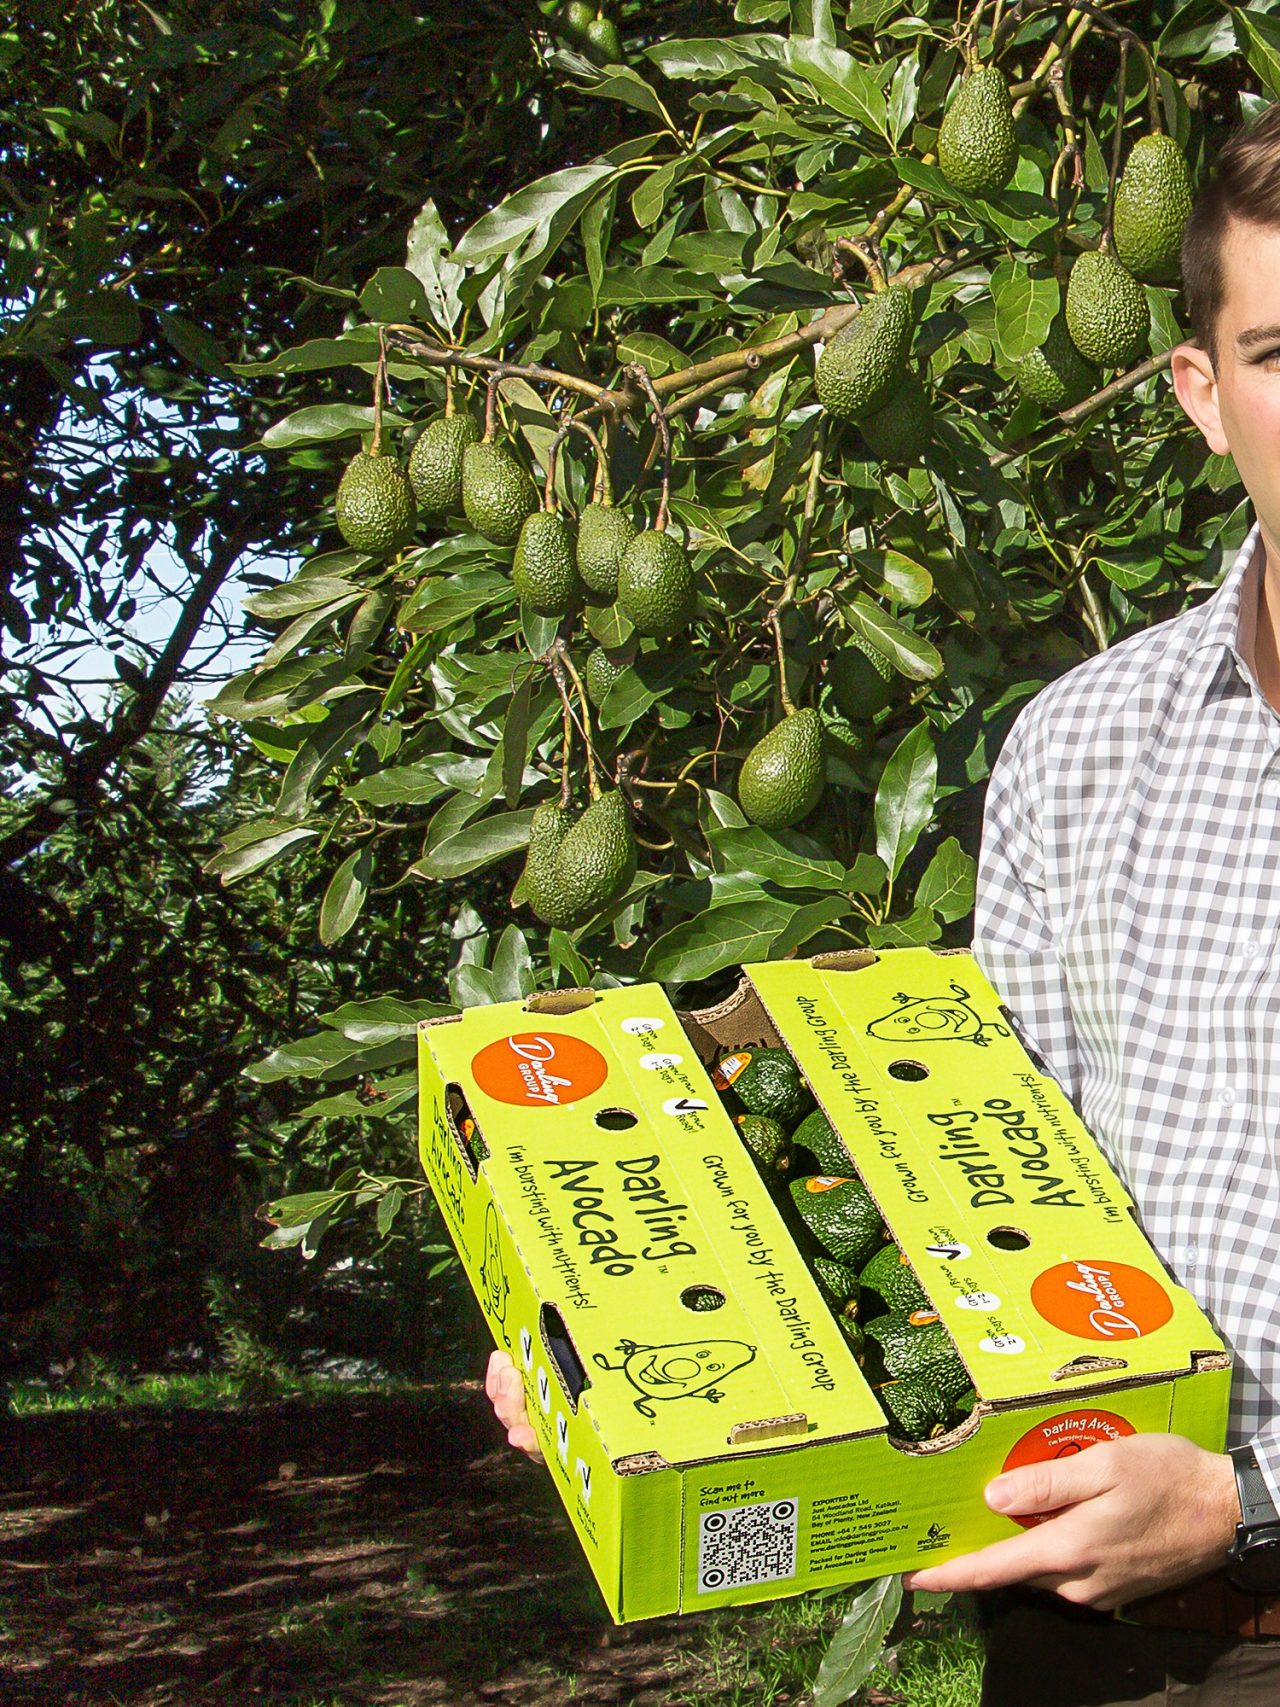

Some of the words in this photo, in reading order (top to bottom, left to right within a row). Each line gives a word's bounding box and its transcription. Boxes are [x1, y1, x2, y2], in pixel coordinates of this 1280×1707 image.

[796, 995, 827, 1027] Group
[814, 1029, 852, 1071] Darling
[508, 1036, 572, 1105] Darling
[518, 1063, 540, 1093] GROUP
[842, 1073, 871, 1094] the
[853, 1097, 879, 1113] by
[1012, 1073, 1061, 1126] nutrients!
[864, 1115, 897, 1136] you
[507, 1145, 526, 1163] I'm
[878, 1138, 902, 1159] for
[982, 1098, 1085, 1207] Avocado
[1054, 1128, 1081, 1155] with
[927, 1111, 1015, 1208] Darling
[702, 1155, 734, 1198] Grown
[895, 1162, 929, 1203] Grown
[1070, 1157, 1111, 1204] bursting
[515, 1165, 550, 1215] bursting
[543, 1160, 638, 1277] Avocado
[615, 1154, 697, 1261] Darling
[727, 1200, 749, 1220] for
[1103, 1206, 1123, 1223] I'm
[537, 1216, 563, 1246] with
[730, 1224, 763, 1247] you
[748, 1248, 774, 1266] by
[552, 1248, 597, 1309] nutrients!
[755, 1271, 786, 1296] the
[1066, 1261, 1141, 1337] Darling
[1097, 1275, 1125, 1308] GROUP
[776, 1297, 815, 1350] Darling
[801, 1351, 836, 1392] Group
[1042, 1418, 1087, 1438] Darling
[1088, 1417, 1121, 1440] Avoca
[700, 1486, 724, 1496] Scan
[726, 1483, 741, 1491] me
[744, 1480, 755, 1490] to
[722, 1493, 738, 1503] out
[741, 1489, 765, 1499] more
[812, 1496, 848, 1507] EXPORTED
[823, 1509, 854, 1519] Woodland
[827, 1502, 856, 1511] Avocados
[872, 1508, 897, 1517] Zealand
[810, 1538, 832, 1547] EMAIL
[811, 1530, 835, 1540] PHONE
[810, 1556, 833, 1565] Packed
[844, 1550, 868, 1559] Darling
[869, 1546, 888, 1554] Group
[824, 1560, 853, 1569] Avocados
